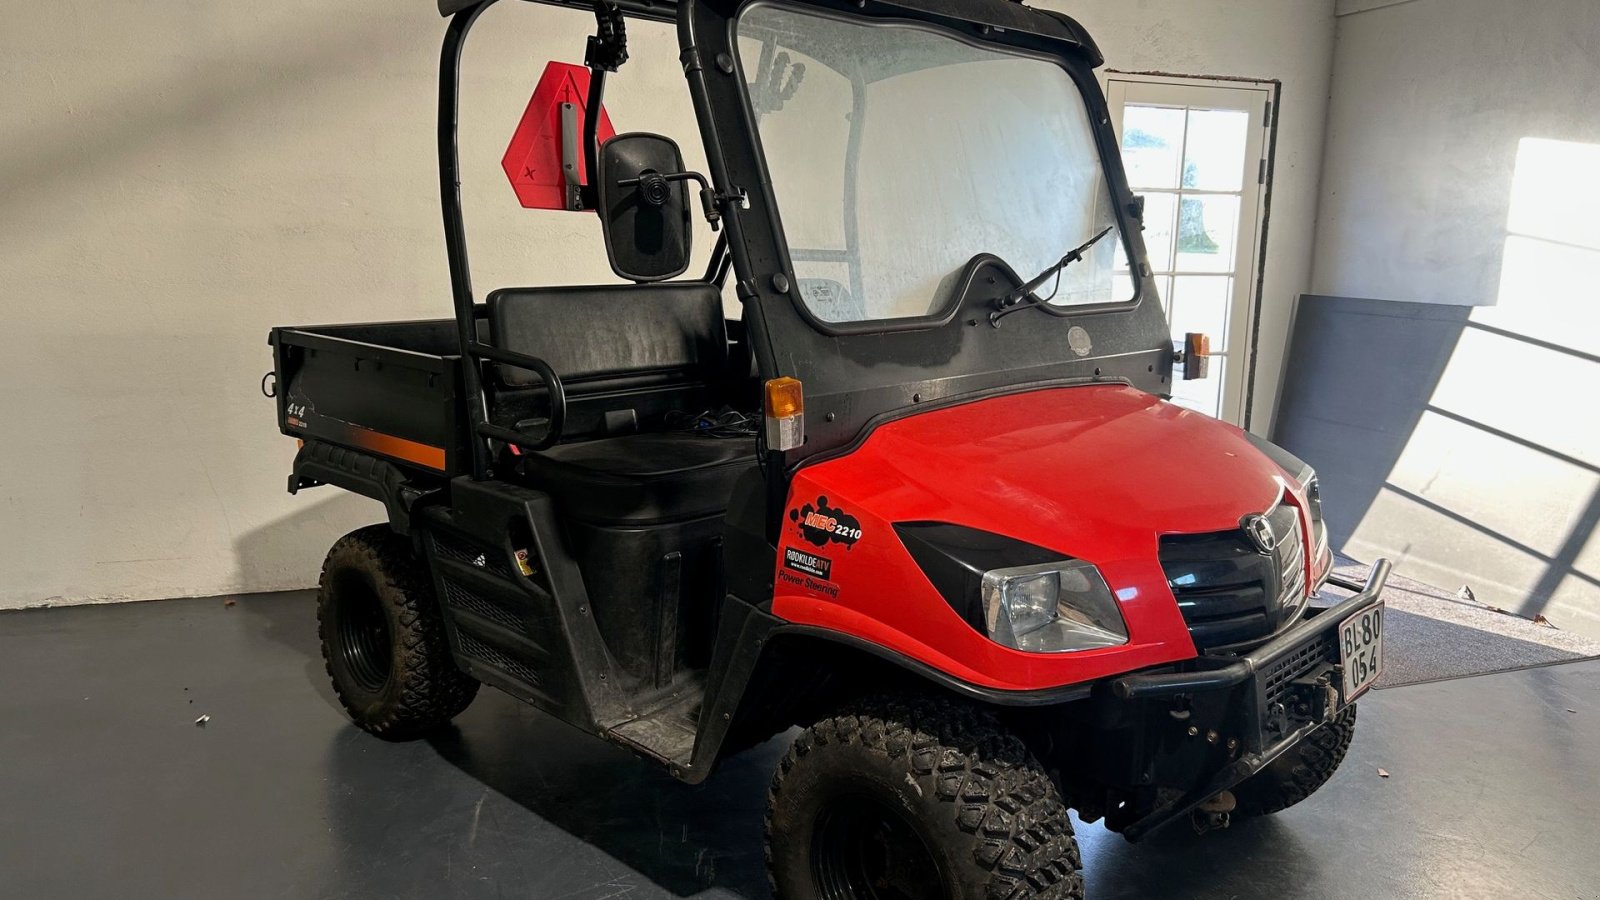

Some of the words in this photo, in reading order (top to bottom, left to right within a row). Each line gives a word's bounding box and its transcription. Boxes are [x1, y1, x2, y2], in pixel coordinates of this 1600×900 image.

[287, 403, 306, 418] 4x4
[804, 512, 838, 532] MEC
[835, 524, 862, 539] 2210
[779, 570, 803, 585] Power
[804, 578, 839, 598] Steering
[1344, 622, 1361, 658] BL
[1361, 609, 1380, 645] 80
[1352, 645, 1377, 688] 054
